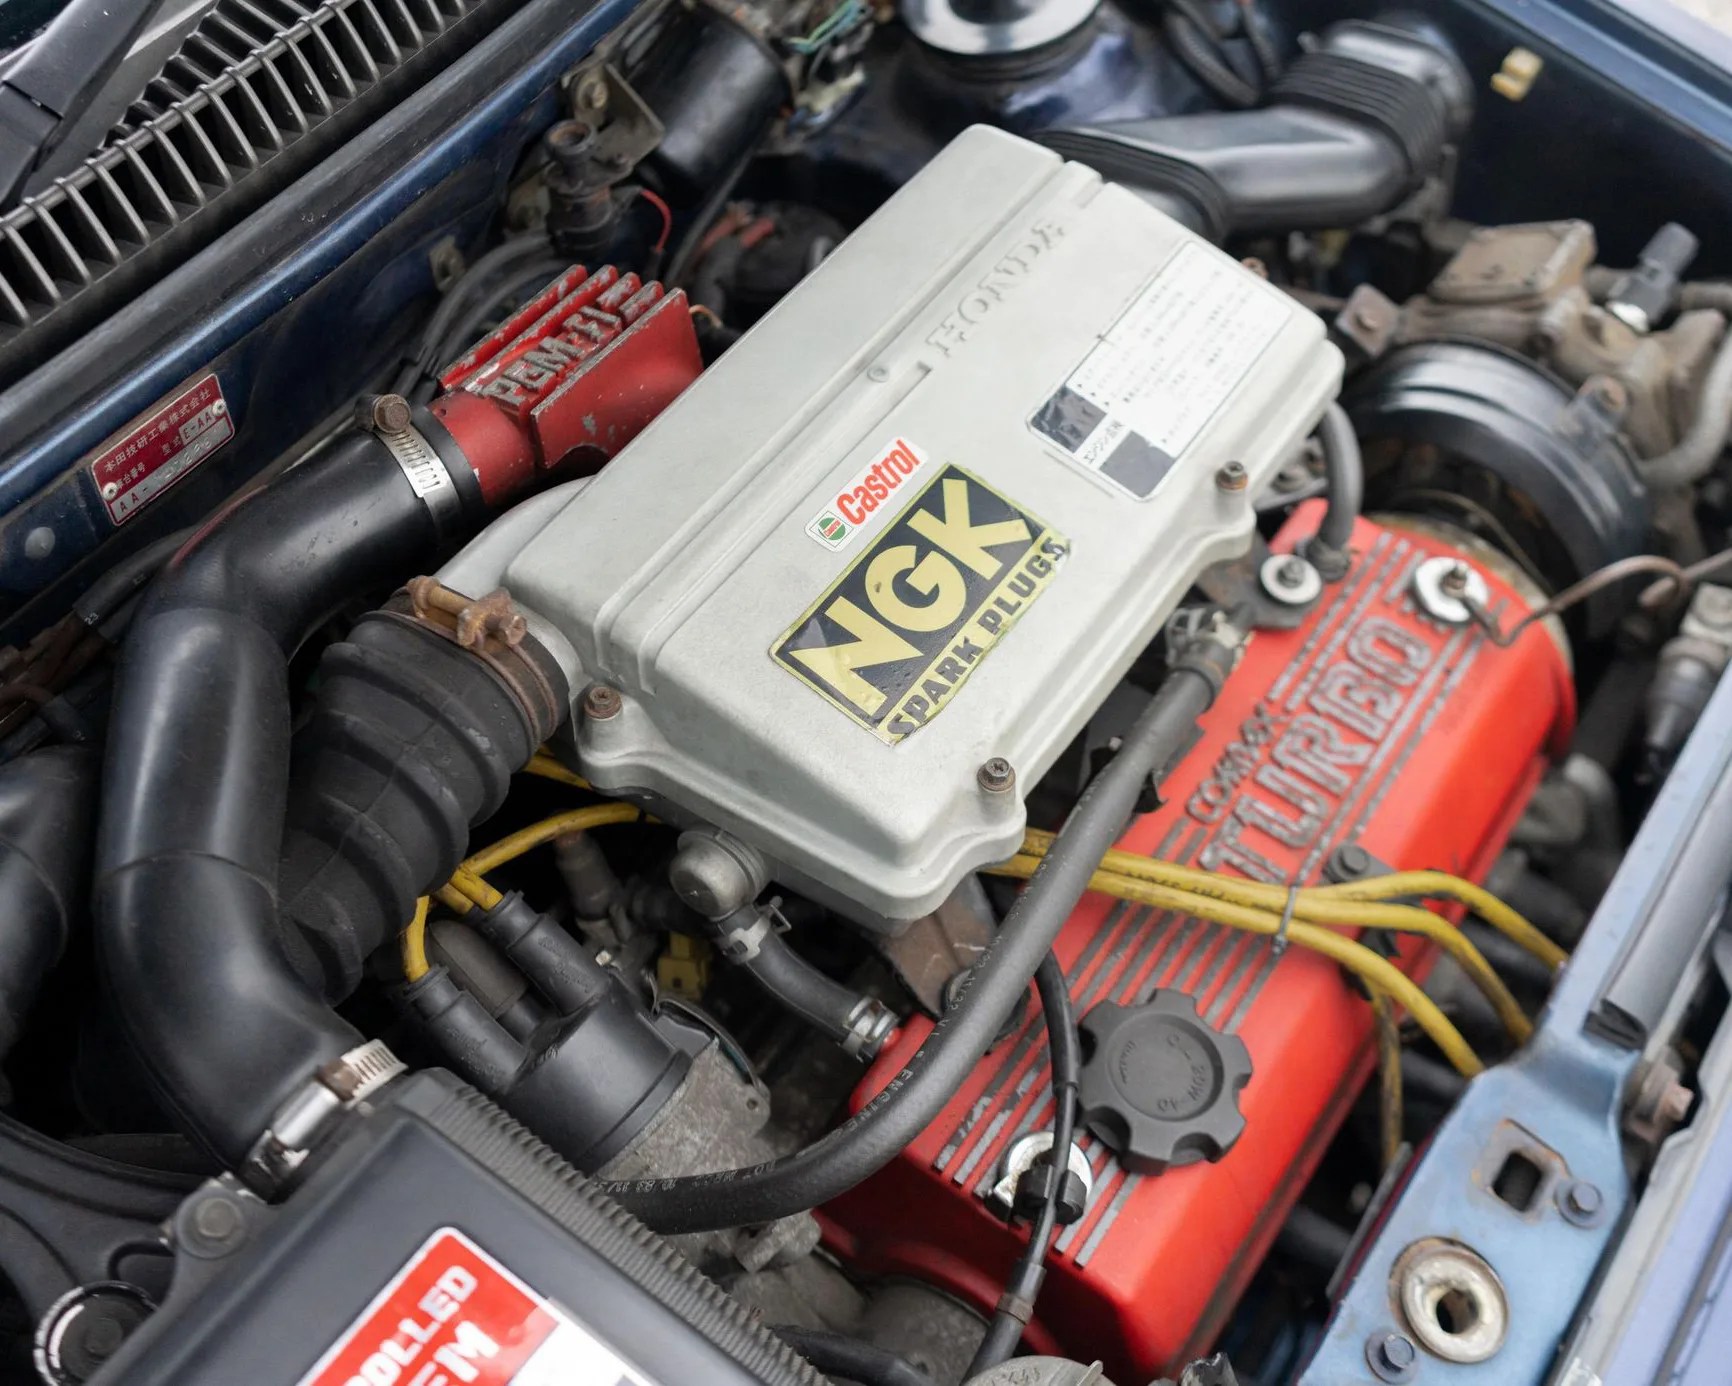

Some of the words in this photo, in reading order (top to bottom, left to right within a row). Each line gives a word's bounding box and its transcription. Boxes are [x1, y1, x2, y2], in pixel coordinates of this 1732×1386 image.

[925, 219, 1064, 357] HONDA
[104, 388, 211, 473] 本田技研工業株式会社
[836, 438, 921, 525] Castrol
[788, 478, 1033, 717] NGK
[887, 636, 984, 735] SPARK
[976, 536, 1065, 636] PLUGS
[1197, 616, 1433, 885] TURBO
[343, 1265, 478, 1386] OLLED
